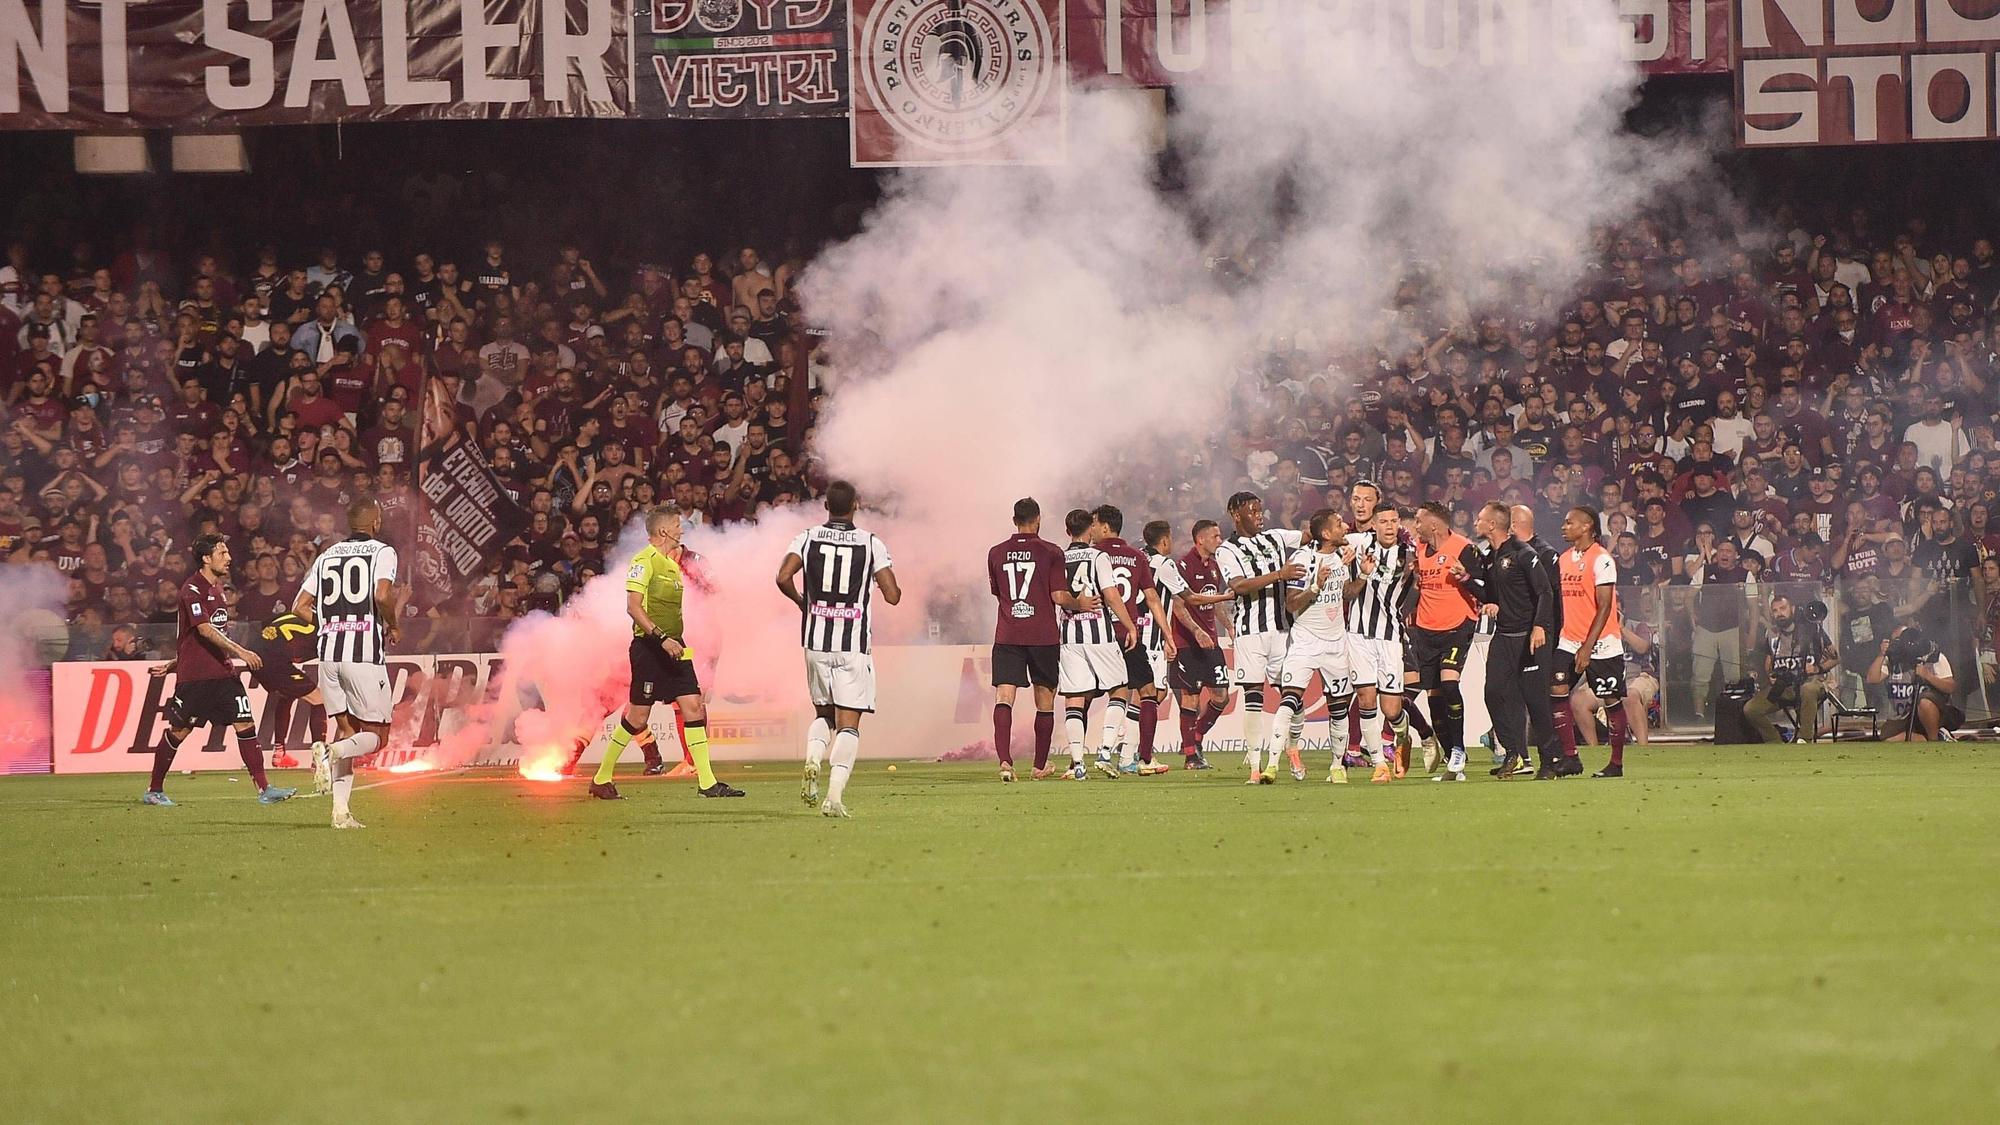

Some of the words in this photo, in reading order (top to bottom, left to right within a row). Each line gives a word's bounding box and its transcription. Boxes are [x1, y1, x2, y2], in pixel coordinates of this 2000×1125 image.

[717, 38, 745, 47] SINCE
[748, 36, 769, 46] 2012
[652, 50, 839, 107] VIETRI
[1743, 52, 2000, 144] STO
[818, 531, 857, 542] WALACE
[1006, 551, 1031, 561] FAZIO
[819, 544, 853, 594] 11
[322, 556, 369, 605] 50
[1003, 561, 1036, 601] 17
[1449, 647, 1458, 661] 1
[1331, 677, 1349, 699] 37
[1386, 673, 1395, 690] 2
[1595, 676, 1618, 692] 22
[235, 695, 251, 713] 10
